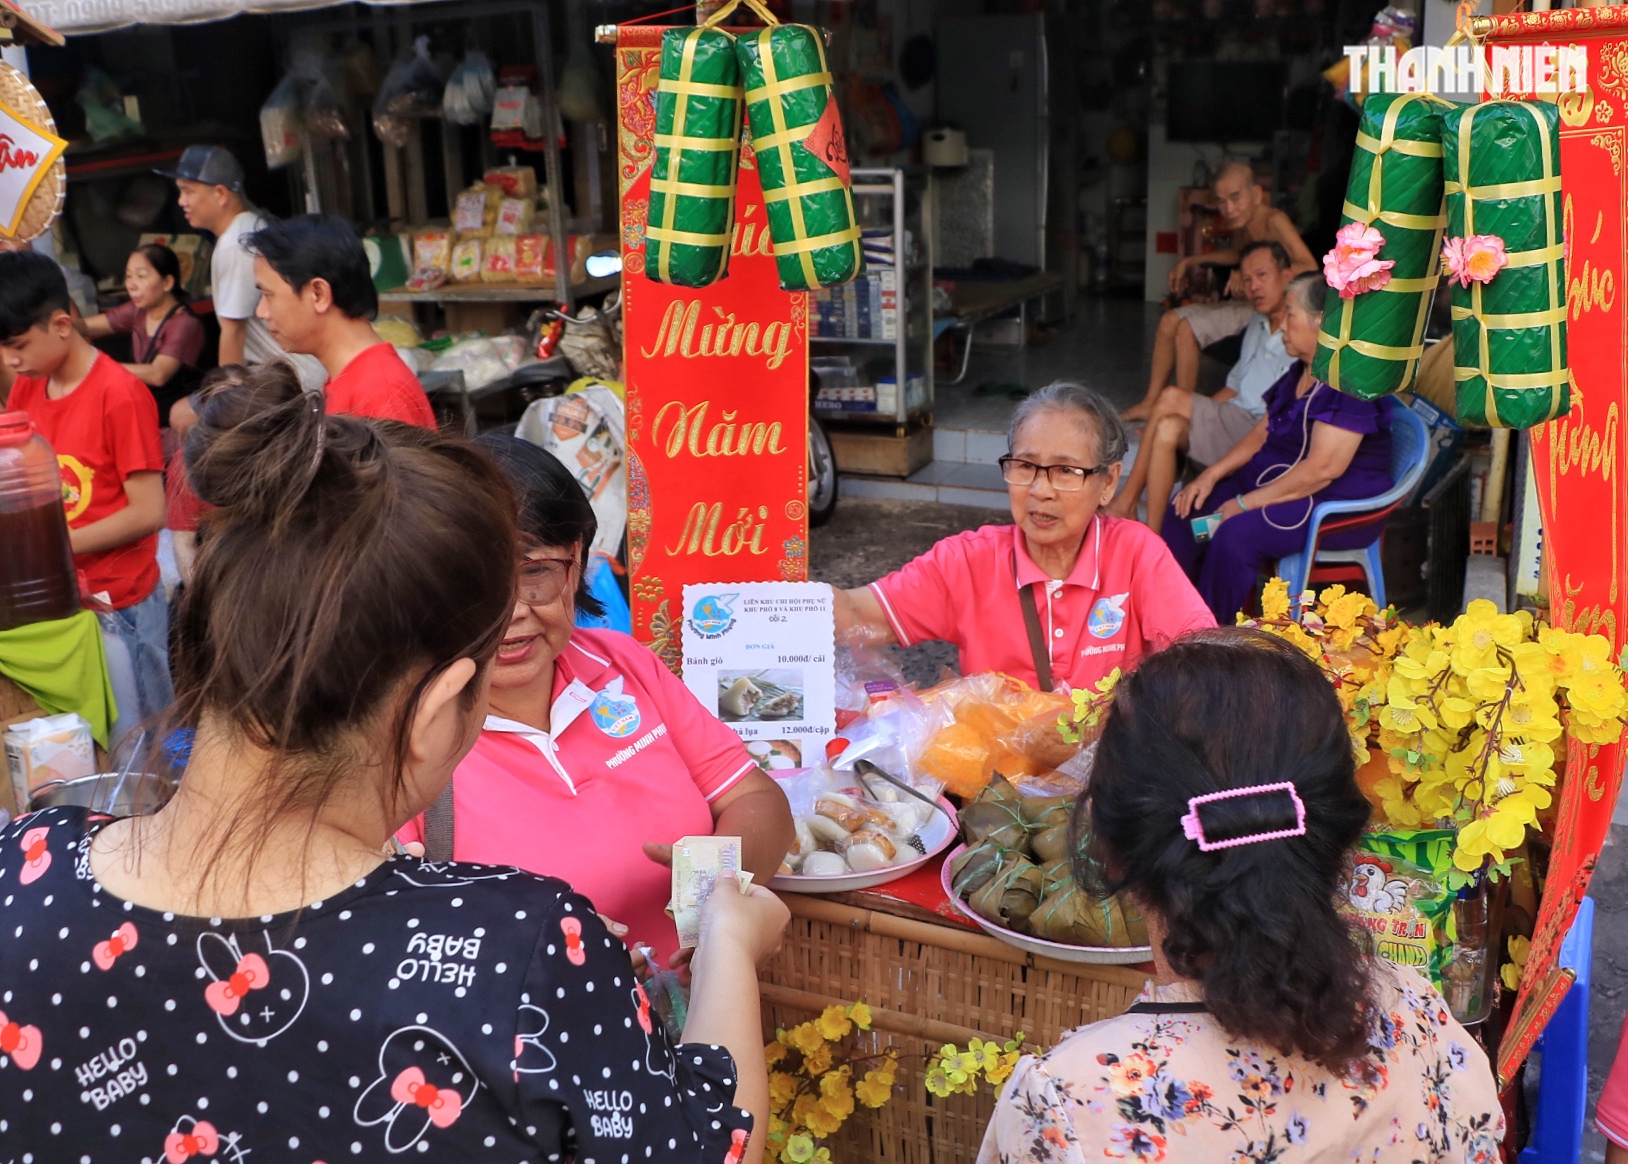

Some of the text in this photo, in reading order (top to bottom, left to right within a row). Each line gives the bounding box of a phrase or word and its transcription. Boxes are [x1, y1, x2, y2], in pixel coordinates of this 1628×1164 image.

[640, 299, 793, 370] Mừng
[652, 400, 787, 458] Năm
[665, 501, 768, 557] Mới
[686, 657, 708, 665] Bánh
[604, 722, 668, 770] PHƯỜNG MINH PHỤ
[744, 727, 758, 738] lụa
[406, 932, 482, 960] BABY
[397, 958, 477, 988] HELLO
[75, 1037, 137, 1087] HELLO
[90, 1060, 149, 1112] BABY
[583, 1089, 634, 1112] HELLO
[592, 1115, 634, 1139] BABY
